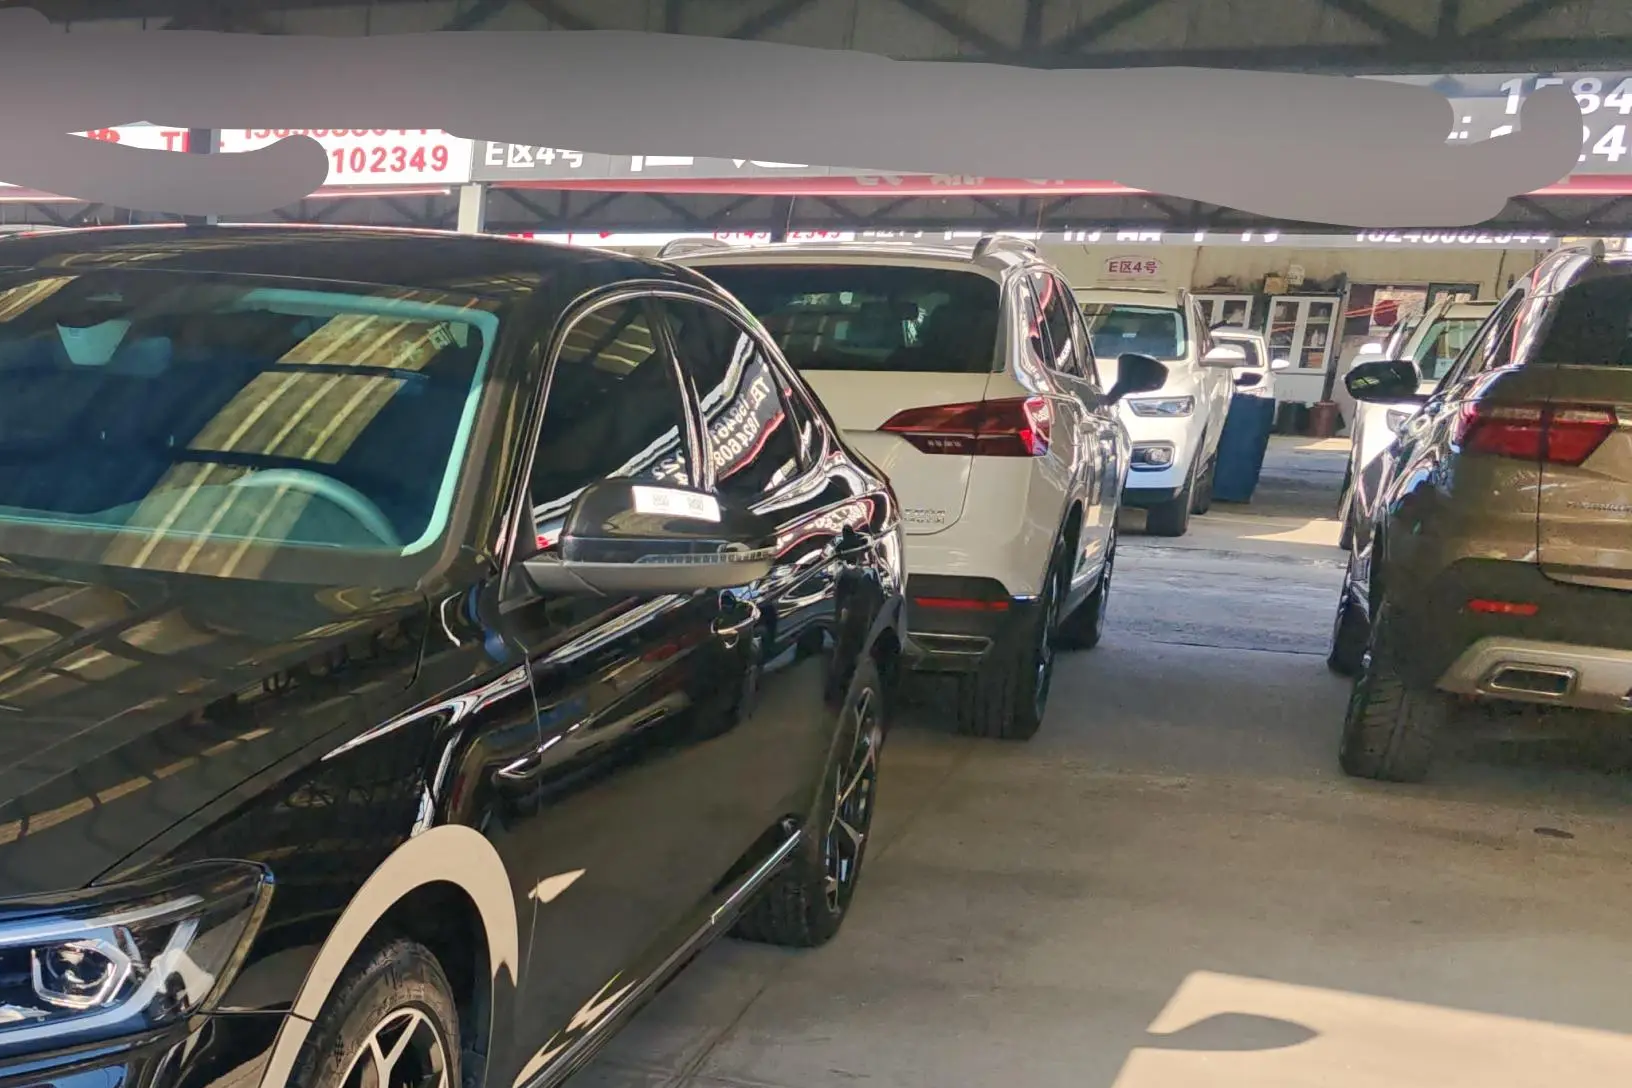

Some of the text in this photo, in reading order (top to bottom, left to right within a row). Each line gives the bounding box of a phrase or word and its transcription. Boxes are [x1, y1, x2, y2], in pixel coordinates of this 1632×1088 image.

[1499, 76, 1632, 115] 184
[330, 144, 449, 174] 102349
[1108, 261, 1158, 274] E区4号
